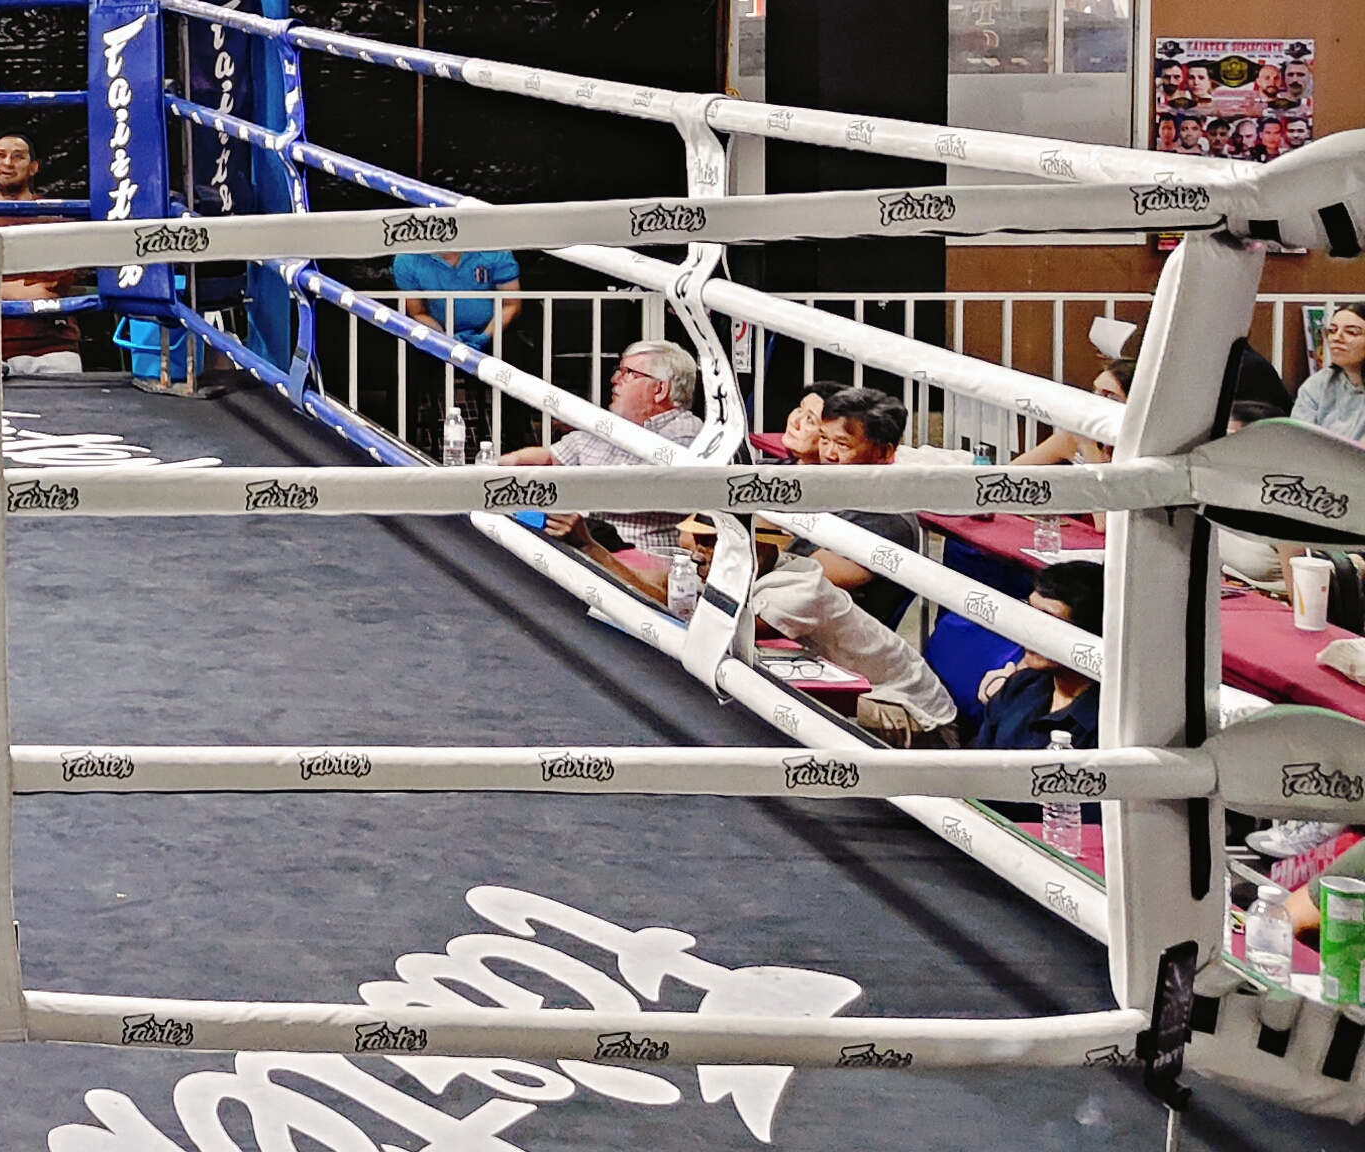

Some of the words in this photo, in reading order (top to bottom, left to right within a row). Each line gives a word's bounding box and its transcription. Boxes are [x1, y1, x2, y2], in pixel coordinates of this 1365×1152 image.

[877, 191, 956, 225] Fairtex
[1131, 182, 1210, 215] Fairtex
[382, 214, 459, 246] Fairtex
[630, 201, 706, 236] Fairtex
[134, 223, 210, 256] Fairtex
[6, 480, 79, 512] Fairtex
[244, 479, 319, 511] Fairtex
[482, 476, 557, 509] Fairtex
[725, 472, 802, 508] Fairtex
[974, 473, 1052, 506] Fairtex
[1260, 474, 1350, 519] Fairtex
[60, 749, 134, 781] Fairtex
[299, 749, 372, 781] Fairtex
[541, 749, 615, 782] Fairtex
[782, 755, 860, 789] Fairtex
[1030, 763, 1107, 798] Fairtex
[121, 1014, 193, 1047] Fairtex
[354, 1022, 428, 1053] Fairtex
